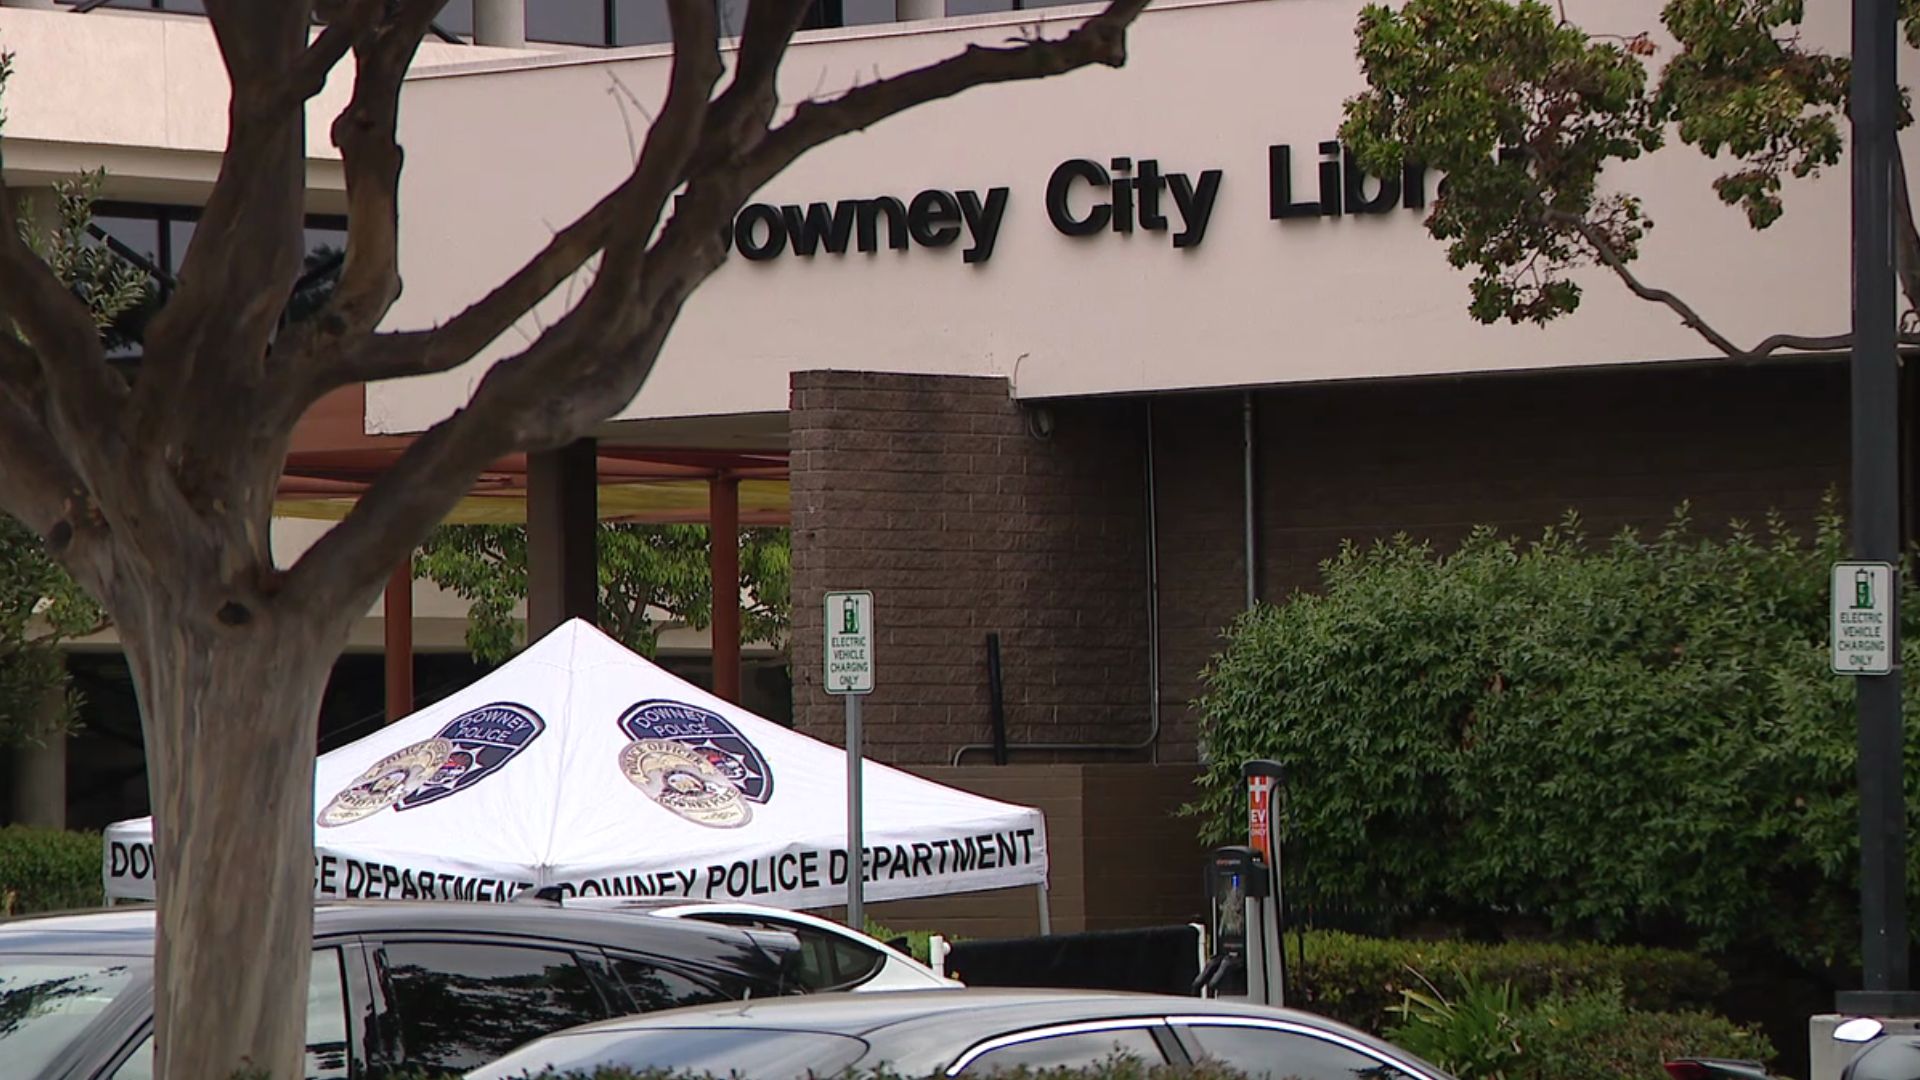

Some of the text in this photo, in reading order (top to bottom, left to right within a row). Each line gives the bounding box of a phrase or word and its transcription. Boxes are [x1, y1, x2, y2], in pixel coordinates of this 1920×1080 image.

[723, 140, 1453, 263] owney City Libr
[1840, 612, 1883, 624] ELECTRIC
[1843, 626, 1880, 637] VEHICLE
[831, 637, 866, 648] ELECTRIC
[1839, 640, 1885, 652] CHARGING
[834, 649, 865, 660] VEHICLE
[1849, 655, 1872, 666] ONLY
[830, 662, 868, 673] CHARGING
[839, 675, 859, 686] ONLY
[458, 710, 529, 731] DOWNEY
[635, 707, 707, 729] DOWNEY
[456, 726, 512, 743] POLICE
[653, 723, 714, 737] POLICE
[1252, 809, 1266, 823] EV
[346, 858, 534, 903] DEPARTMEN
[706, 851, 820, 899] POLICE
